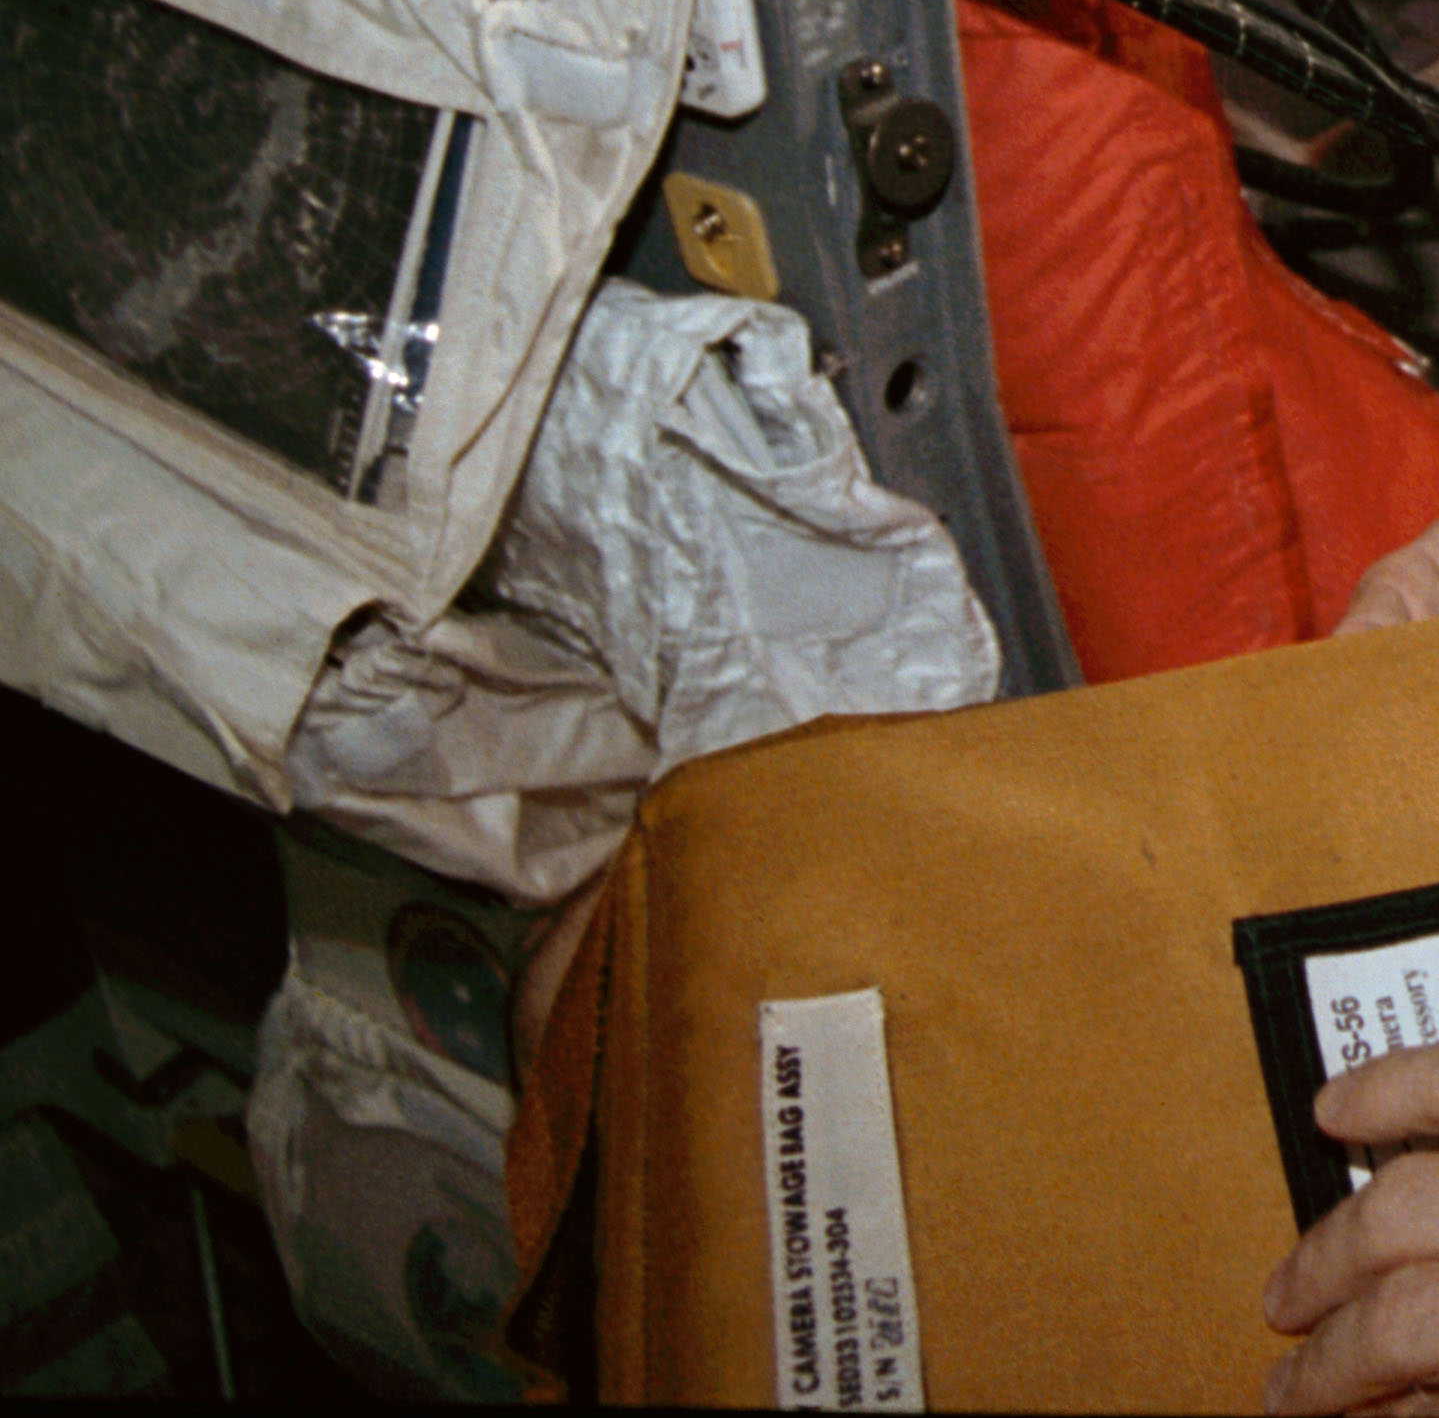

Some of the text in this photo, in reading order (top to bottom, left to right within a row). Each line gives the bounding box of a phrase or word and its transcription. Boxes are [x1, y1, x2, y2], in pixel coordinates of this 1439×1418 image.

[776, 1046, 802, 1099] ASSY
[778, 1104, 805, 1156] BAG
[780, 1158, 813, 1281] STOWAGE
[789, 1286, 820, 1395] CAMERA
